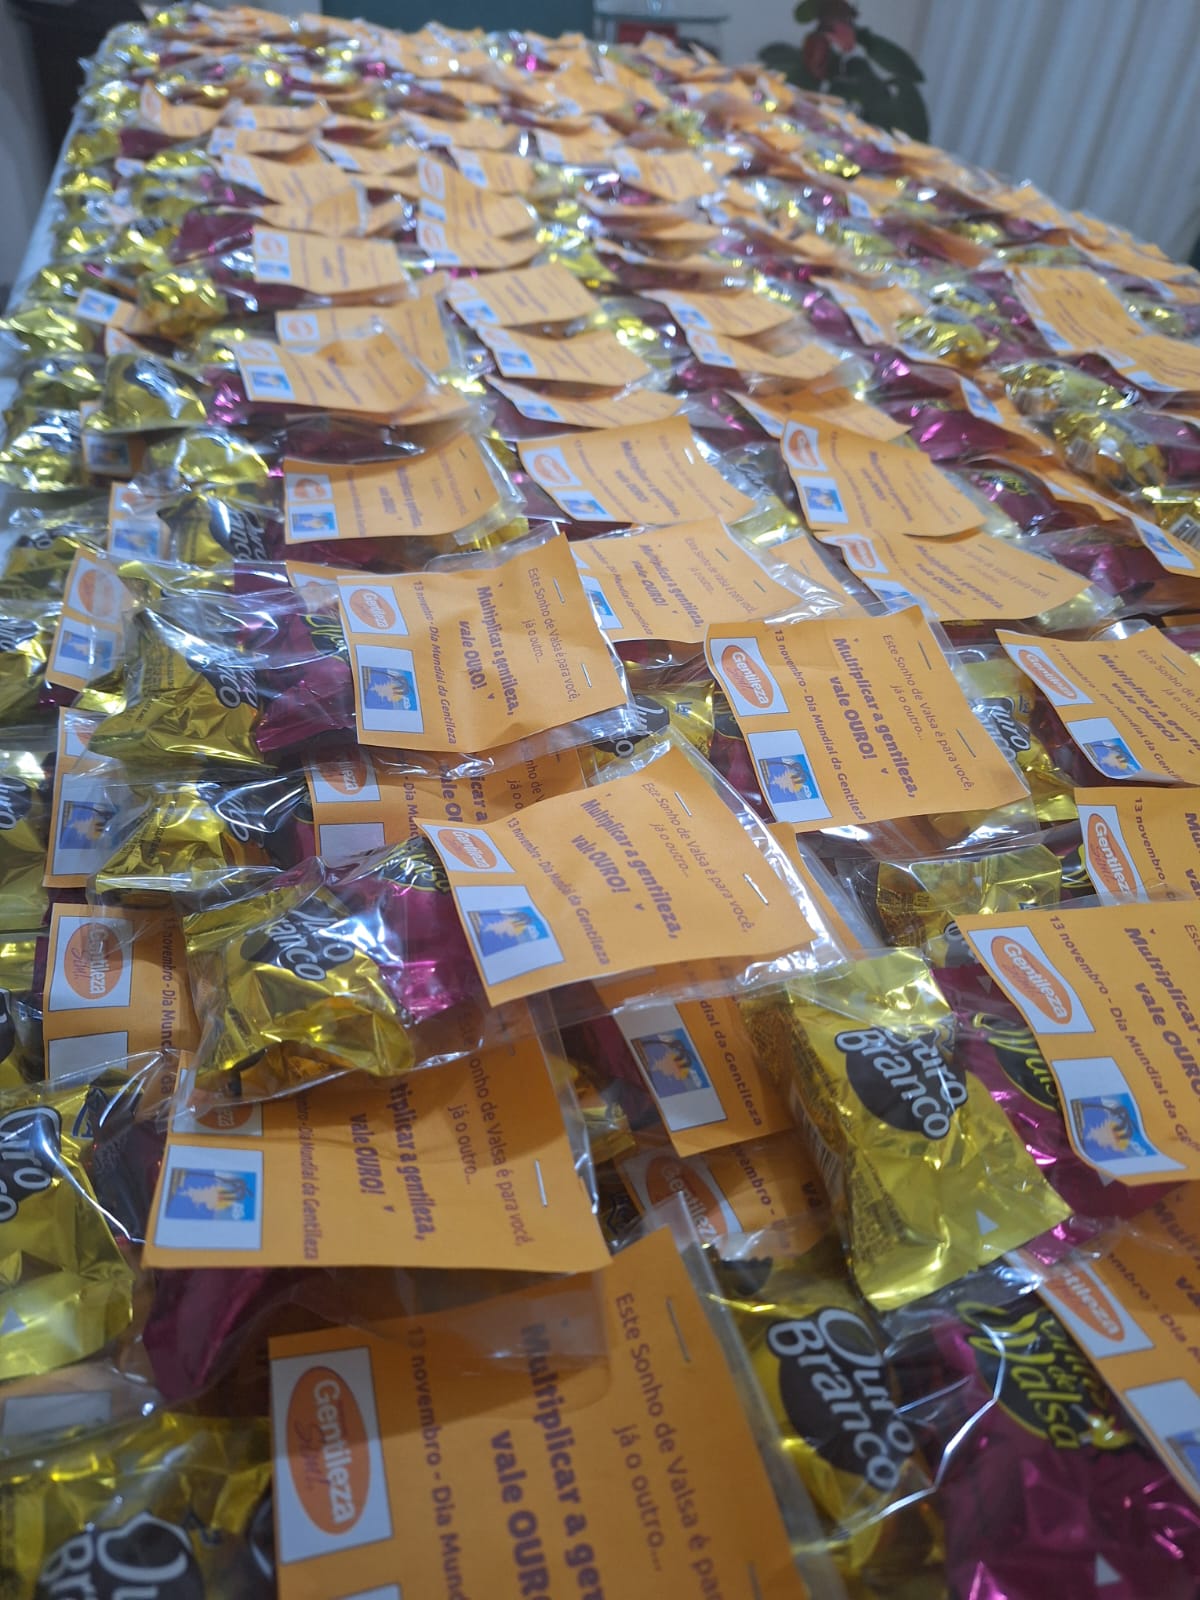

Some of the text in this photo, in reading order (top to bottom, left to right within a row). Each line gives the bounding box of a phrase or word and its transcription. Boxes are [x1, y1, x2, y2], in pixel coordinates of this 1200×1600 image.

[528, 567, 540, 586] Este
[534, 586, 550, 617] Sonho
[544, 617, 554, 630] de
[549, 629, 563, 650] Valsa
[431, 643, 447, 684] Mundial
[438, 684, 447, 696] da
[459, 621, 487, 690] vale OURO!
[476, 586, 505, 652] Multiplicar
[491, 657, 519, 716] gentileza,
[732, 651, 770, 705] Gentileza
[890, 684, 904, 695] já
[440, 698, 457, 745] Gentileza
[774, 629, 867, 821] 13 novembro Dia Mundial da Gentileza
[829, 676, 878, 760] vale OURO!
[833, 638, 919, 798] Multiplicar a gentileza,
[882, 634, 896, 656] Este
[895, 655, 916, 686] Sonho
[911, 686, 923, 701] de
[919, 702, 939, 729] Valsa
[936, 737, 958, 763] para
[953, 763, 975, 791] você,
[403, 782, 417, 800] Dia
[507, 777, 522, 789] já
[588, 851, 631, 893] OURO!
[656, 798, 682, 827] Sonho
[676, 827, 691, 840] de
[687, 840, 711, 868] Valsa
[707, 876, 733, 901] para
[1134, 797, 1166, 881] 13 novembro
[507, 817, 519, 829] 13
[575, 907, 611, 966] Gentileza
[627, 859, 682, 940] gentileza,
[267, 918, 327, 980] anco
[1003, 943, 1068, 1019] Gentileza
[161, 989, 176, 1007] Dia
[1049, 915, 1178, 1119] 13 novembro Dia Mundial da
[1134, 982, 1167, 1027] vale
[714, 1030, 728, 1049] da
[724, 1051, 763, 1127] Gentileza
[835, 1029, 950, 1138] Branco
[884, 1026, 968, 1106] Ouro
[448, 1104, 468, 1118] já
[481, 1103, 495, 1123] de
[487, 1124, 507, 1166] Valsa
[300, 1142, 319, 1180] Mundial
[302, 1181, 316, 1197] da
[350, 1113, 385, 1196] vale OURO!
[389, 1083, 436, 1241] tiplicar a gentileza,
[303, 1198, 323, 1261] Gentileza
[496, 1180, 519, 1210] para
[508, 1211, 535, 1248] você,
[407, 1326, 426, 1349] 13
[1160, 1312, 1188, 1343] Dia
[410, 1354, 443, 1467] novembro
[767, 1321, 899, 1490] Branco
[816, 1307, 915, 1454] Ouro
[969, 1331, 1084, 1449] Valsa
[313, 1379, 356, 1525] Gentileza
[520, 1322, 582, 1504] Multiplicar
[563, 1513, 588, 1537] a
[615, 1293, 641, 1341] Este
[631, 1342, 665, 1418] Sonho
[654, 1421, 678, 1453] de
[667, 1455, 699, 1529] Valsa
[688, 1534, 711, 1551] é
[431, 1485, 456, 1527] Dia
[490, 1428, 554, 1600] vale OUR
[612, 1424, 666, 1572] já o outro...
